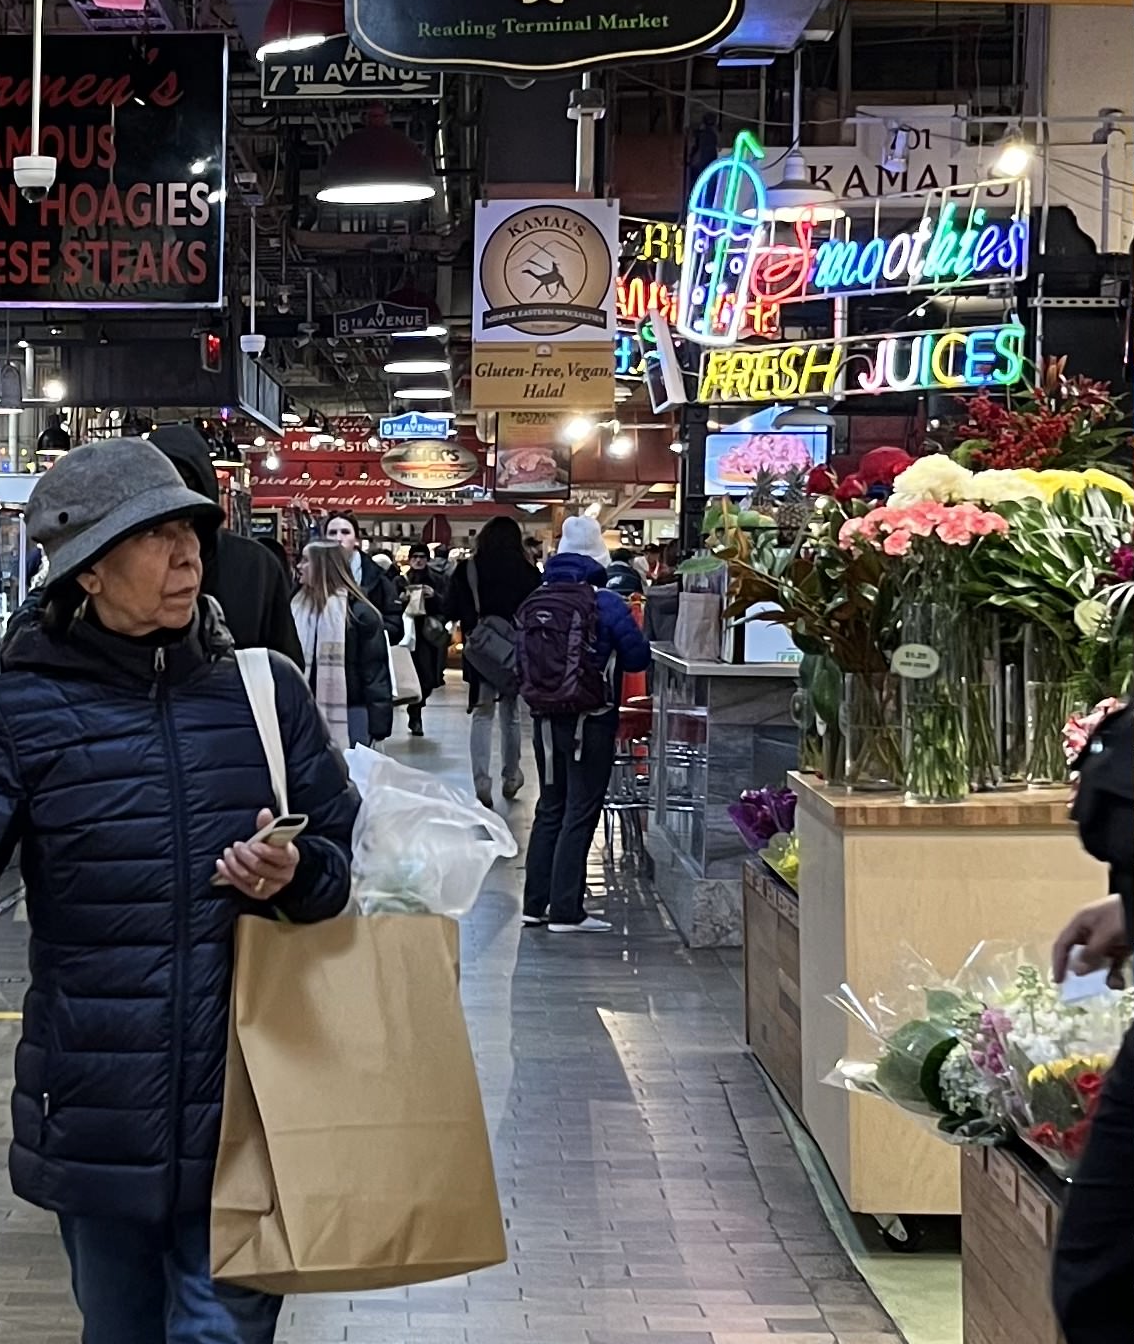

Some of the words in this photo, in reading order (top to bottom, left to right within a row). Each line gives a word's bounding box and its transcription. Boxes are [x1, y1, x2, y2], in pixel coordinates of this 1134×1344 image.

[417, 20, 497, 39] Reading
[501, 14, 592, 34] Terminal
[598, 13, 670, 31] Market
[40, 181, 210, 227] HOAGIES
[506, 215, 588, 239] KAMAL'S
[61, 239, 208, 285] STEAKS
[751, 202, 1027, 302] Smoothies
[366, 313, 425, 328] AVENUE
[518, 308, 554, 317] EASTERN
[474, 362, 565, 379] Gluten-Free,
[567, 362, 613, 382] Vegan,
[700, 344, 842, 402] FRESH
[857, 325, 1026, 392] JUICES
[523, 383, 566, 399] Halal
[403, 422, 445, 432] AVENUE
